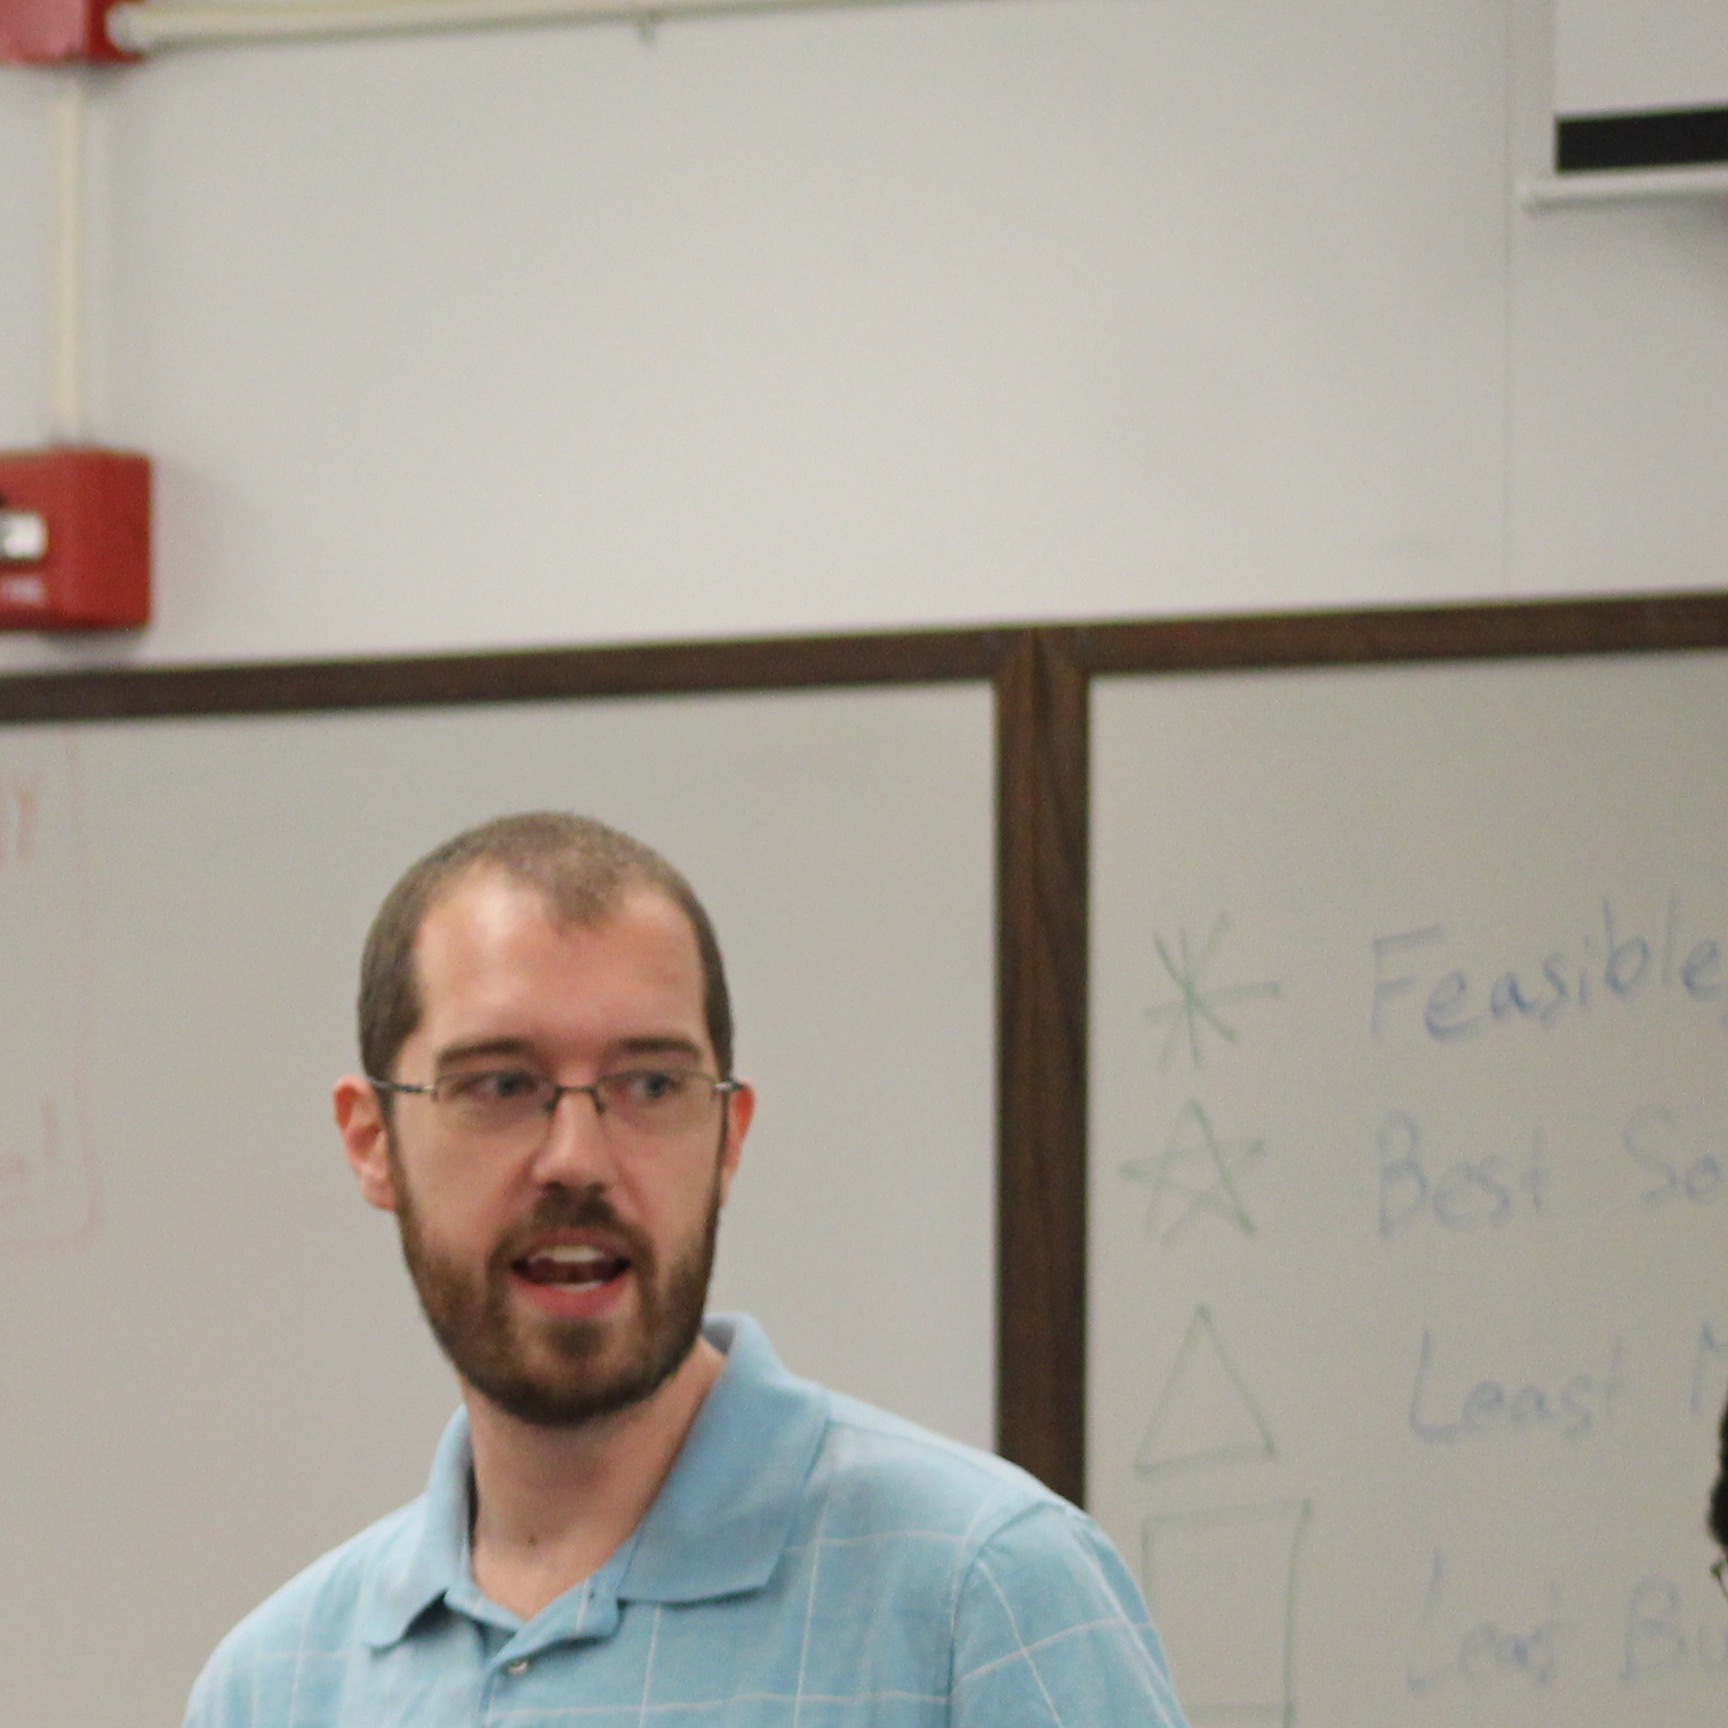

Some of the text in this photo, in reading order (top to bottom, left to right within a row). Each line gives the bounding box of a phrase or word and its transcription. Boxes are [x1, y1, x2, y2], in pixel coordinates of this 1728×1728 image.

[1375, 1104, 1728, 1242] Best So
[1409, 1328, 1628, 1446] Least
